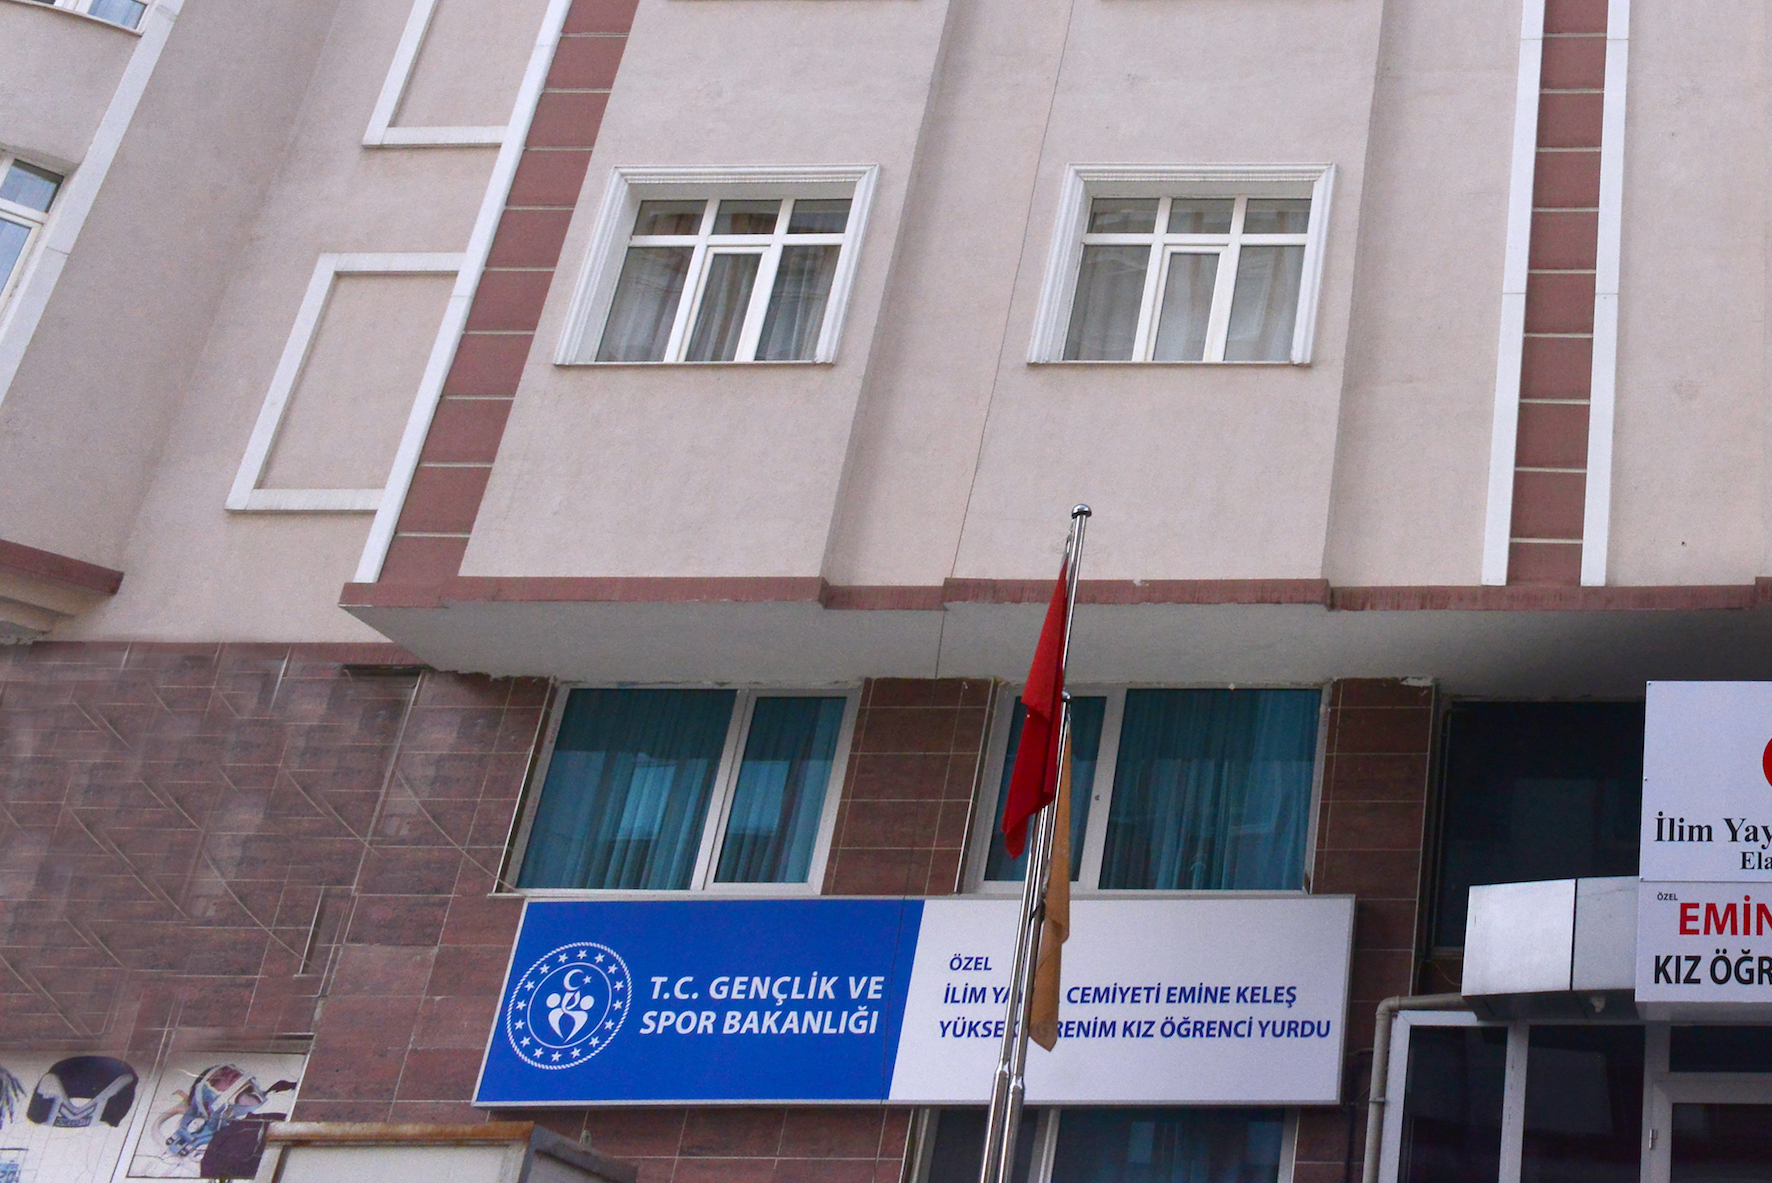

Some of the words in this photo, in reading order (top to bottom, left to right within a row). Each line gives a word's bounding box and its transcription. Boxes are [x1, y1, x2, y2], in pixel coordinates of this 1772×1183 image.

[1653, 811, 1713, 842] İlim
[1656, 891, 1679, 901] ÖZEL
[949, 953, 993, 971] ÖZEL
[1653, 955, 1702, 985] KIZ
[650, 976, 700, 1000] T.C.
[708, 971, 840, 1006] GENÇLİK
[848, 976, 886, 1000] VE
[943, 983, 987, 1004] İLİM
[1066, 983, 1162, 1005] CEMİYETİ
[1165, 983, 1232, 1004] EMİNE
[1235, 985, 1298, 1008] KELEŞ
[639, 1010, 717, 1035] SPOR
[722, 1005, 880, 1035] BAKANLIĞI
[939, 1016, 1020, 1038] YÜKSE
[1122, 1020, 1156, 1038] KIZ
[1159, 1016, 1254, 1039] ÖĞRENCİ
[1257, 1020, 1331, 1039] YURDU
